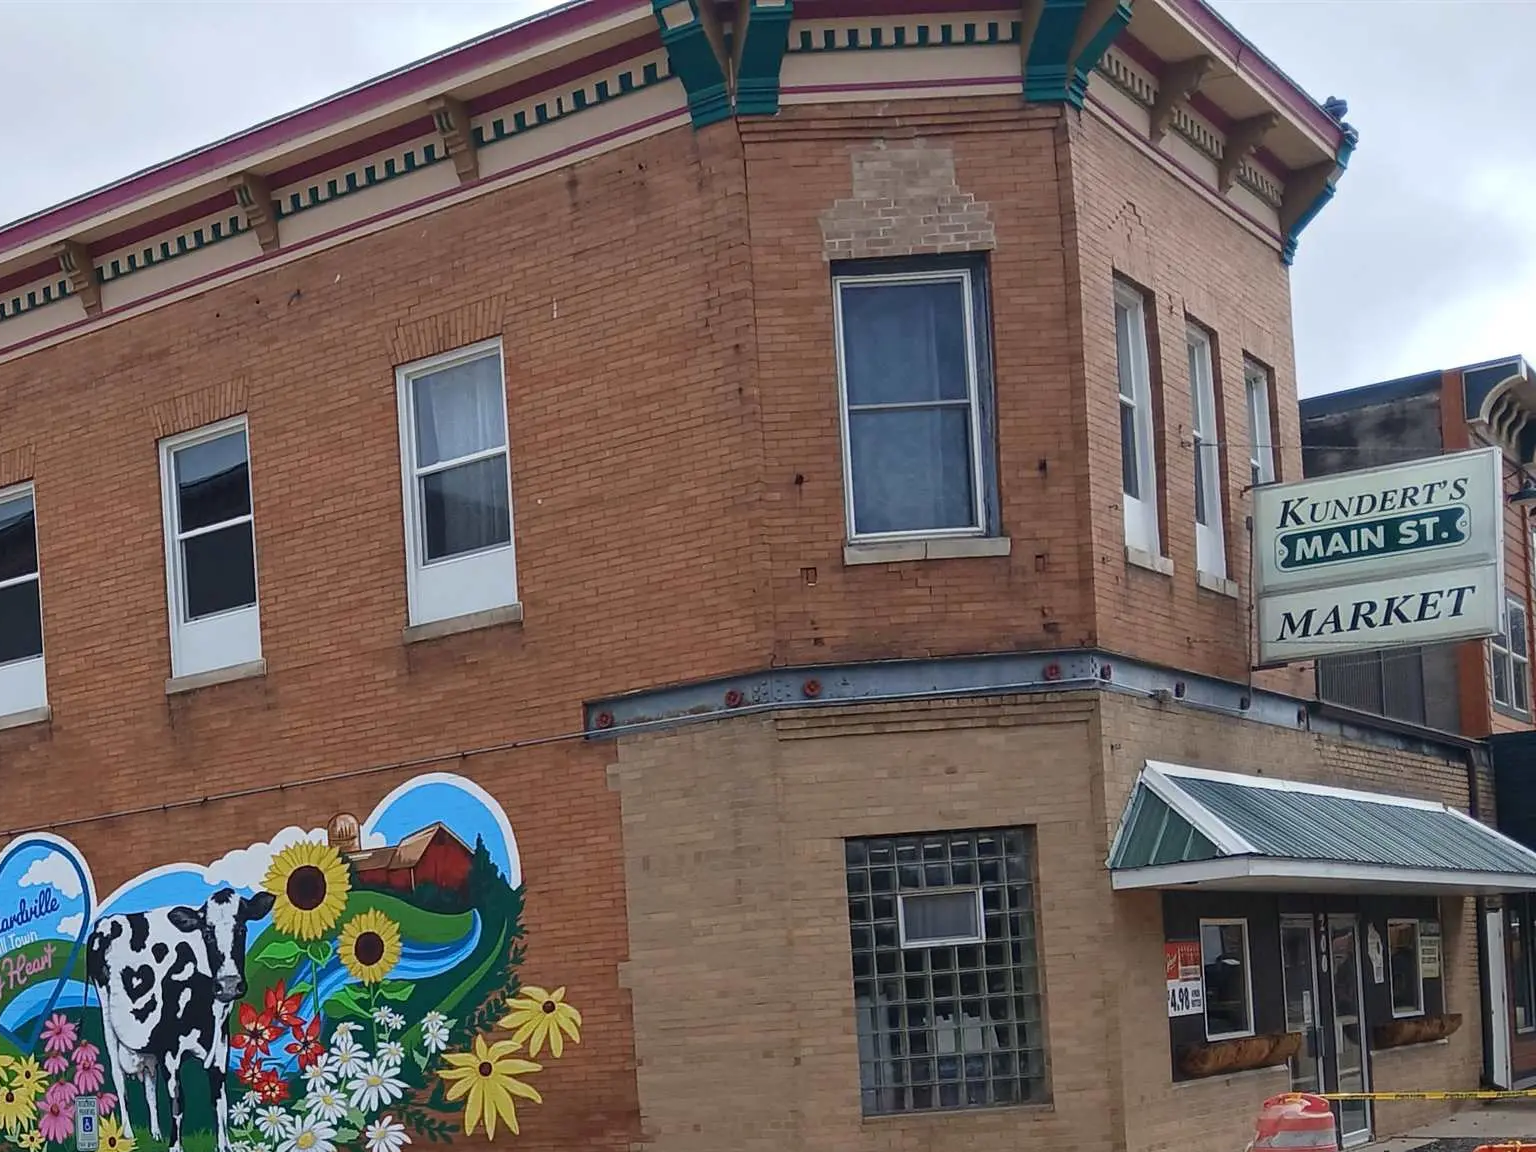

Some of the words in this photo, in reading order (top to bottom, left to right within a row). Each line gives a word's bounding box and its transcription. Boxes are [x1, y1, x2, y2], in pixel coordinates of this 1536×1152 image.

[1275, 477, 1469, 529] KUNDERT'S
[1294, 523, 1386, 562] MAIN
[1397, 516, 1450, 546] ST.
[1276, 585, 1477, 642] MARKET
[9, 930, 39, 951] Town
[1318, 913, 1328, 973] 200
[0, 942, 57, 991] Heart
